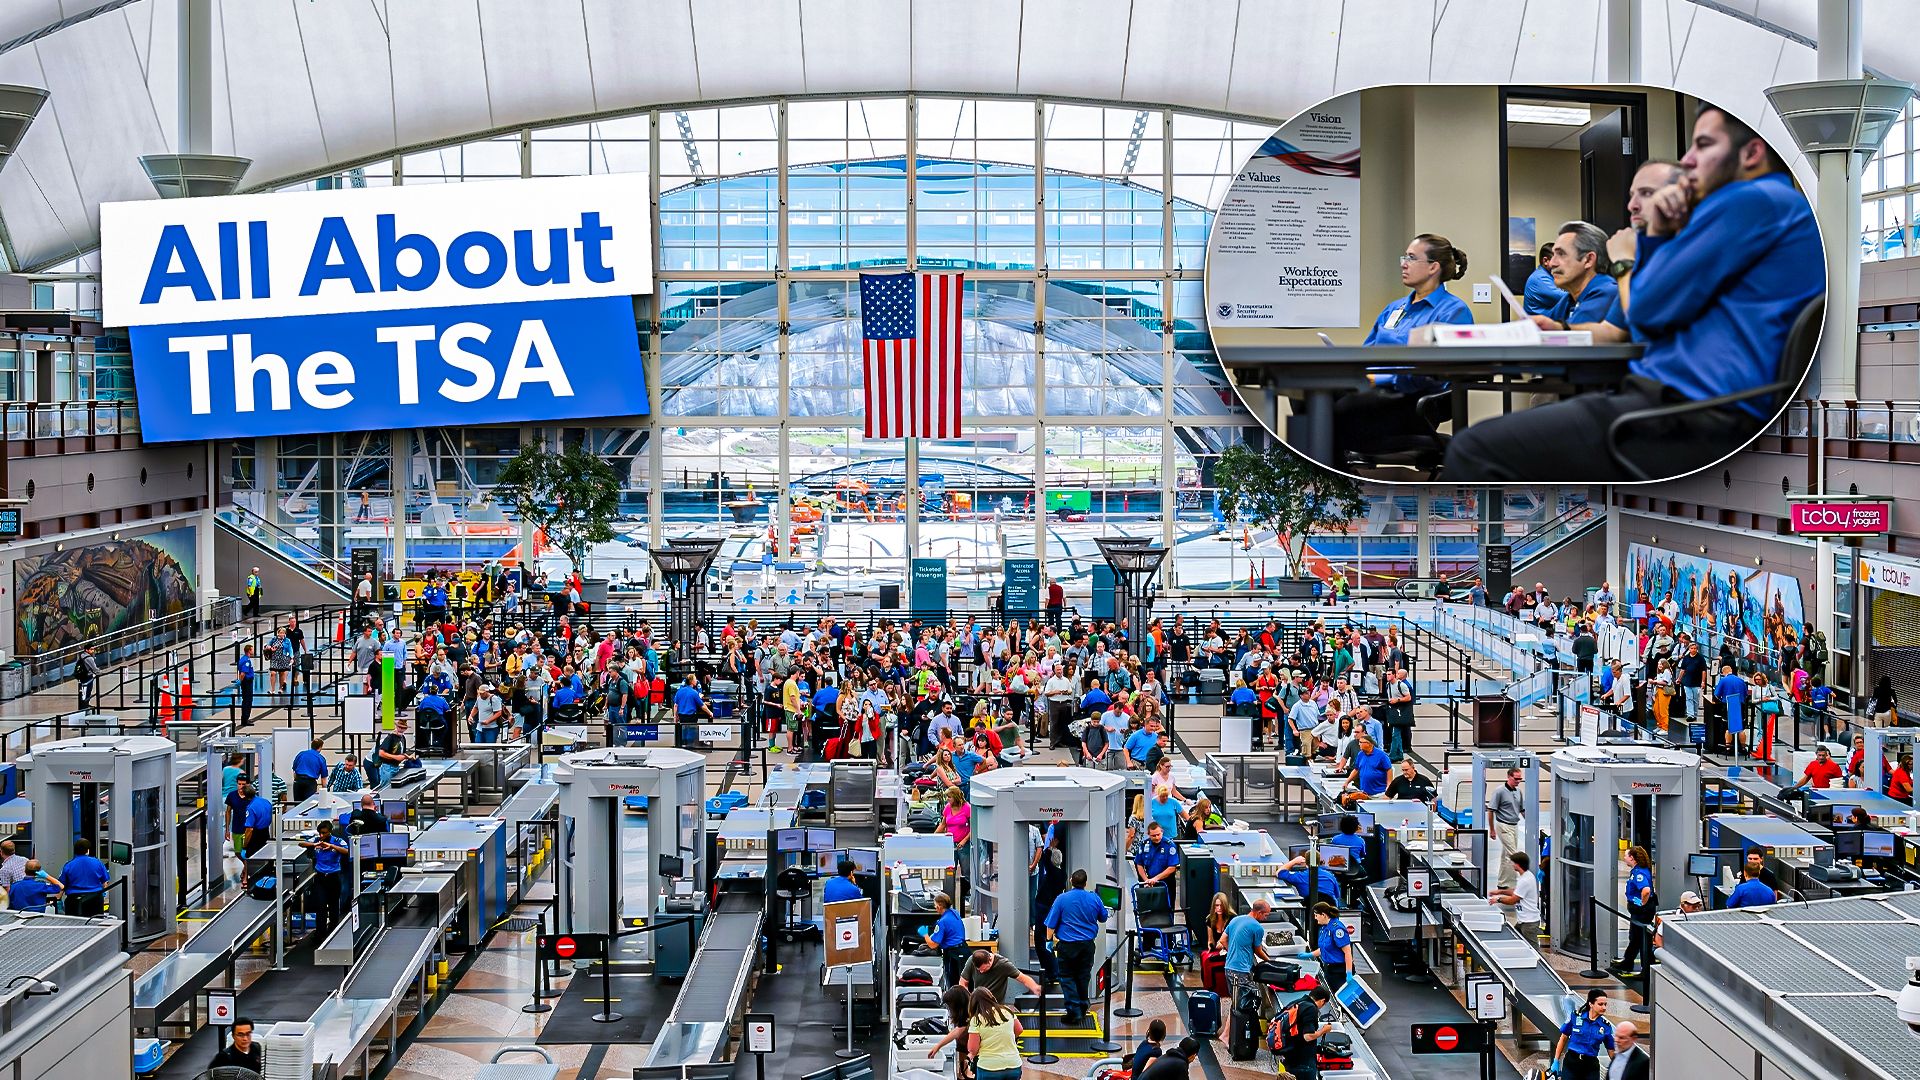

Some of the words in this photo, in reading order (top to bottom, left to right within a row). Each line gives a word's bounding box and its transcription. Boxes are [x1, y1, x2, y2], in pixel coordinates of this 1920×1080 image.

[1310, 112, 1342, 124] Vision
[1235, 173, 1246, 182] re
[1247, 172, 1281, 183] Values
[1284, 266, 1338, 278] Workforce
[1278, 275, 1343, 289] Expectations
[1236, 303, 1273, 311] Transportation
[1853, 508, 1880, 518] frozen
[1853, 517, 1880, 528] yogurt
[1522, 759, 1528, 767] 8
